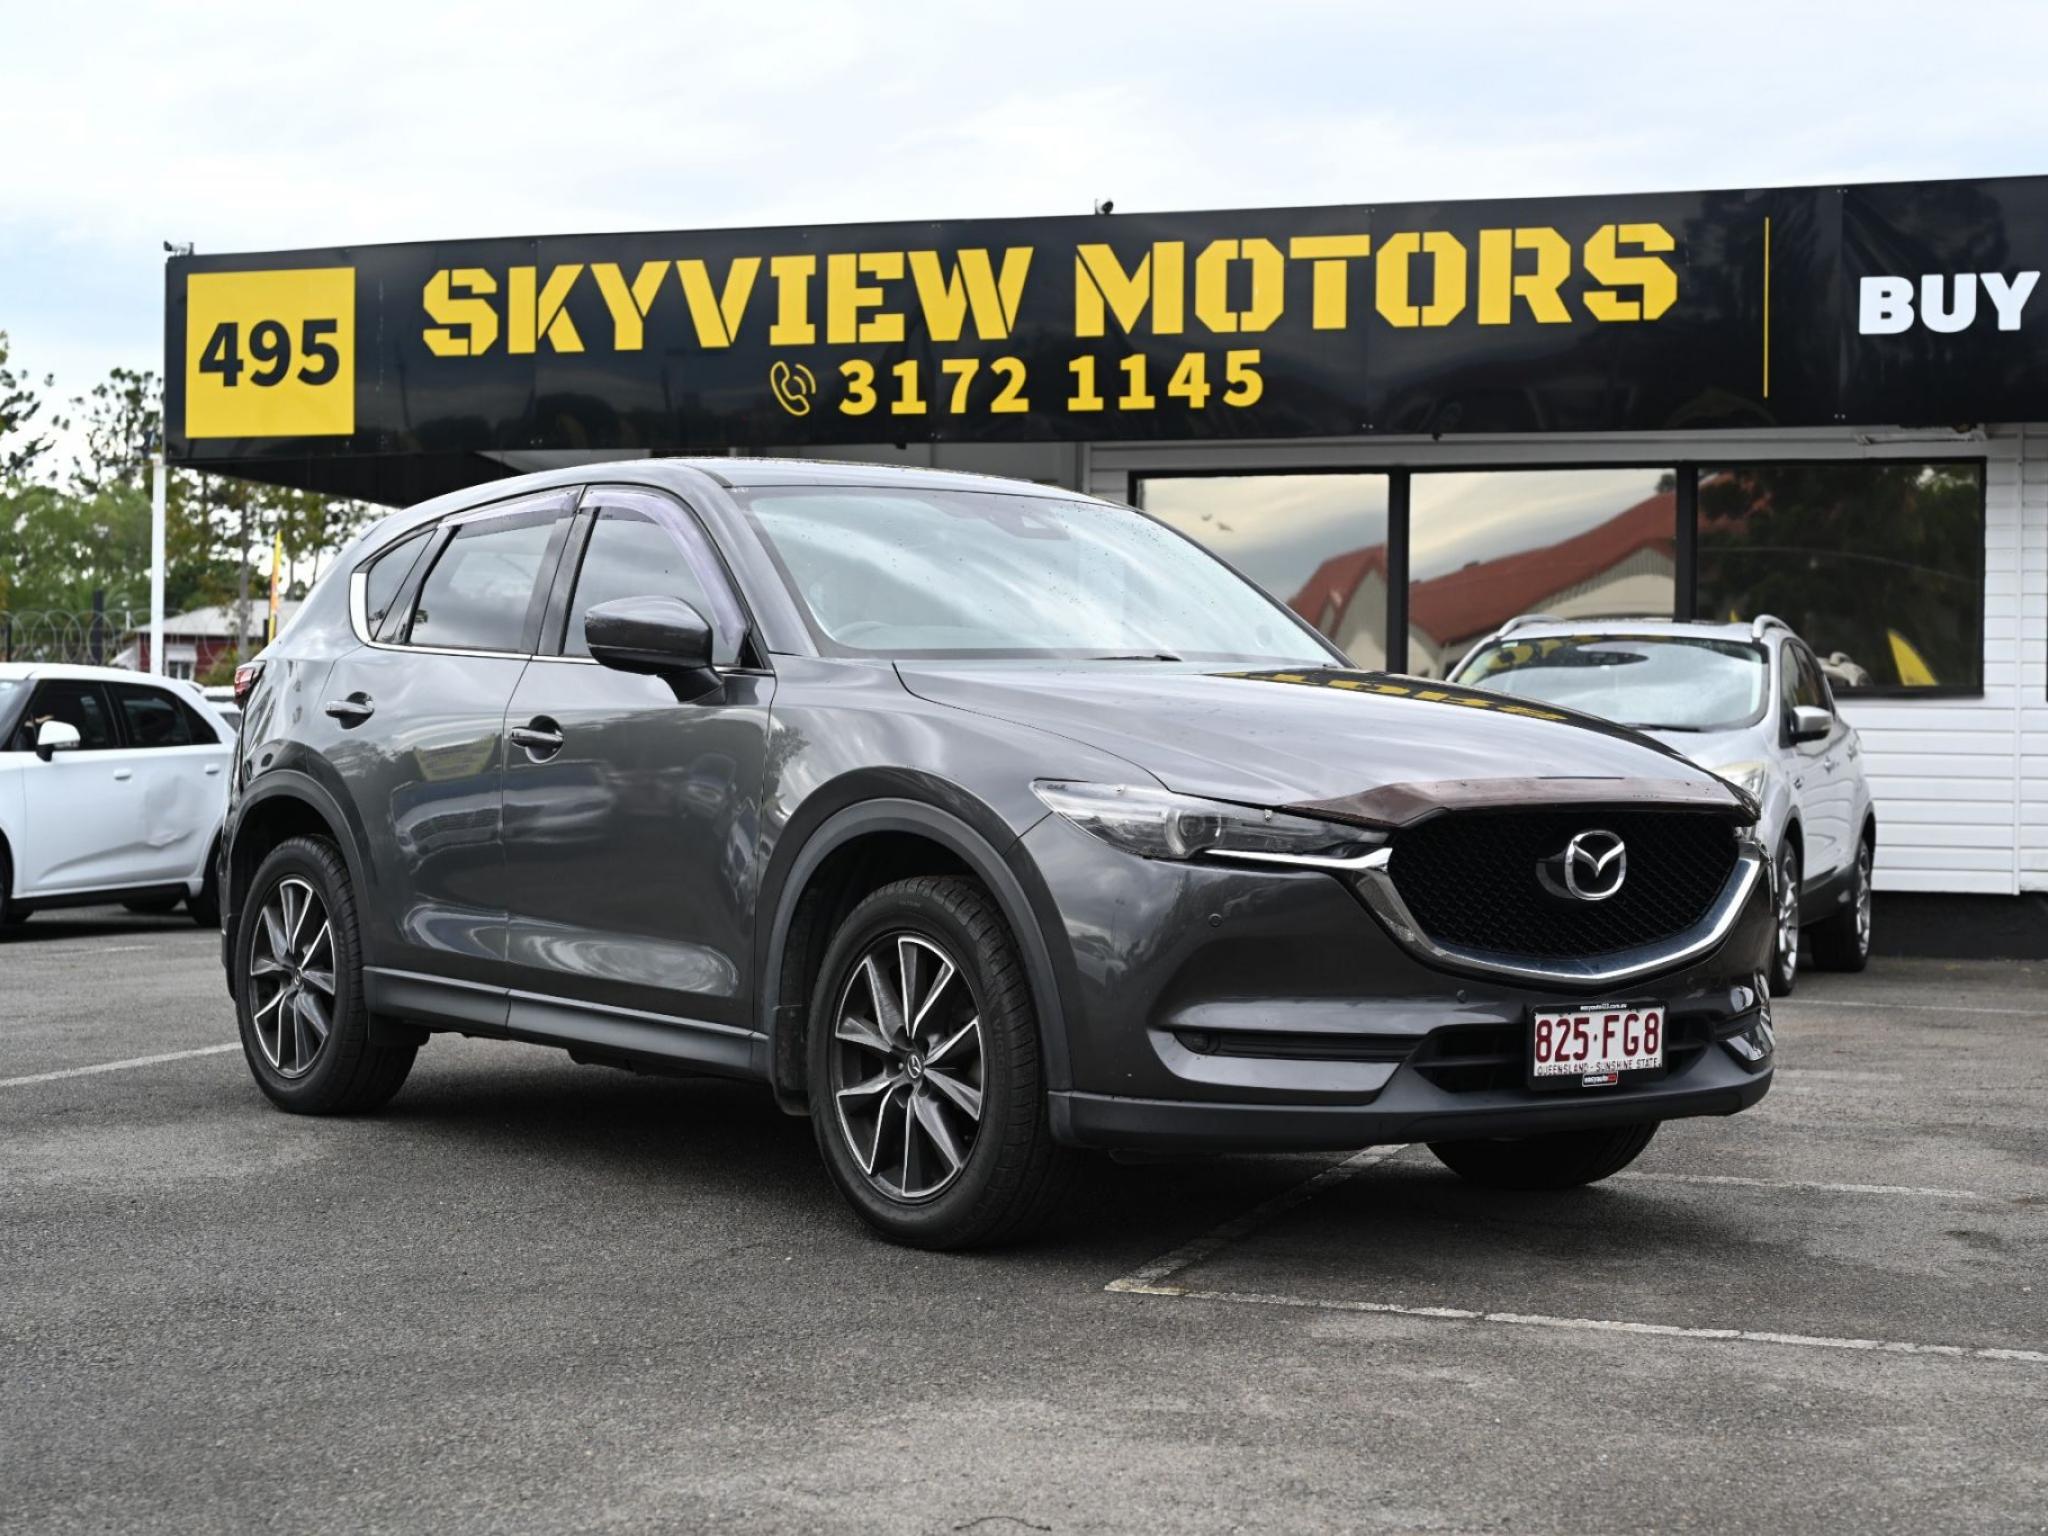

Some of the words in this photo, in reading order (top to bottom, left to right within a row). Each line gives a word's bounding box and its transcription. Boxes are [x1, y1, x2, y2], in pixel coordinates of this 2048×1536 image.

[423, 246, 1034, 357] SKYVIEW
[1075, 223, 1678, 338] MOTORS
[1858, 271, 2042, 335] BUY
[199, 318, 340, 388] 495
[838, 356, 1030, 416] 3172
[1067, 348, 1264, 412] 1145
[1537, 1061, 1589, 1076] QUEENSLAND
[1596, 1058, 1633, 1073] SUNSHINE
[1636, 1057, 1658, 1069] STATE
